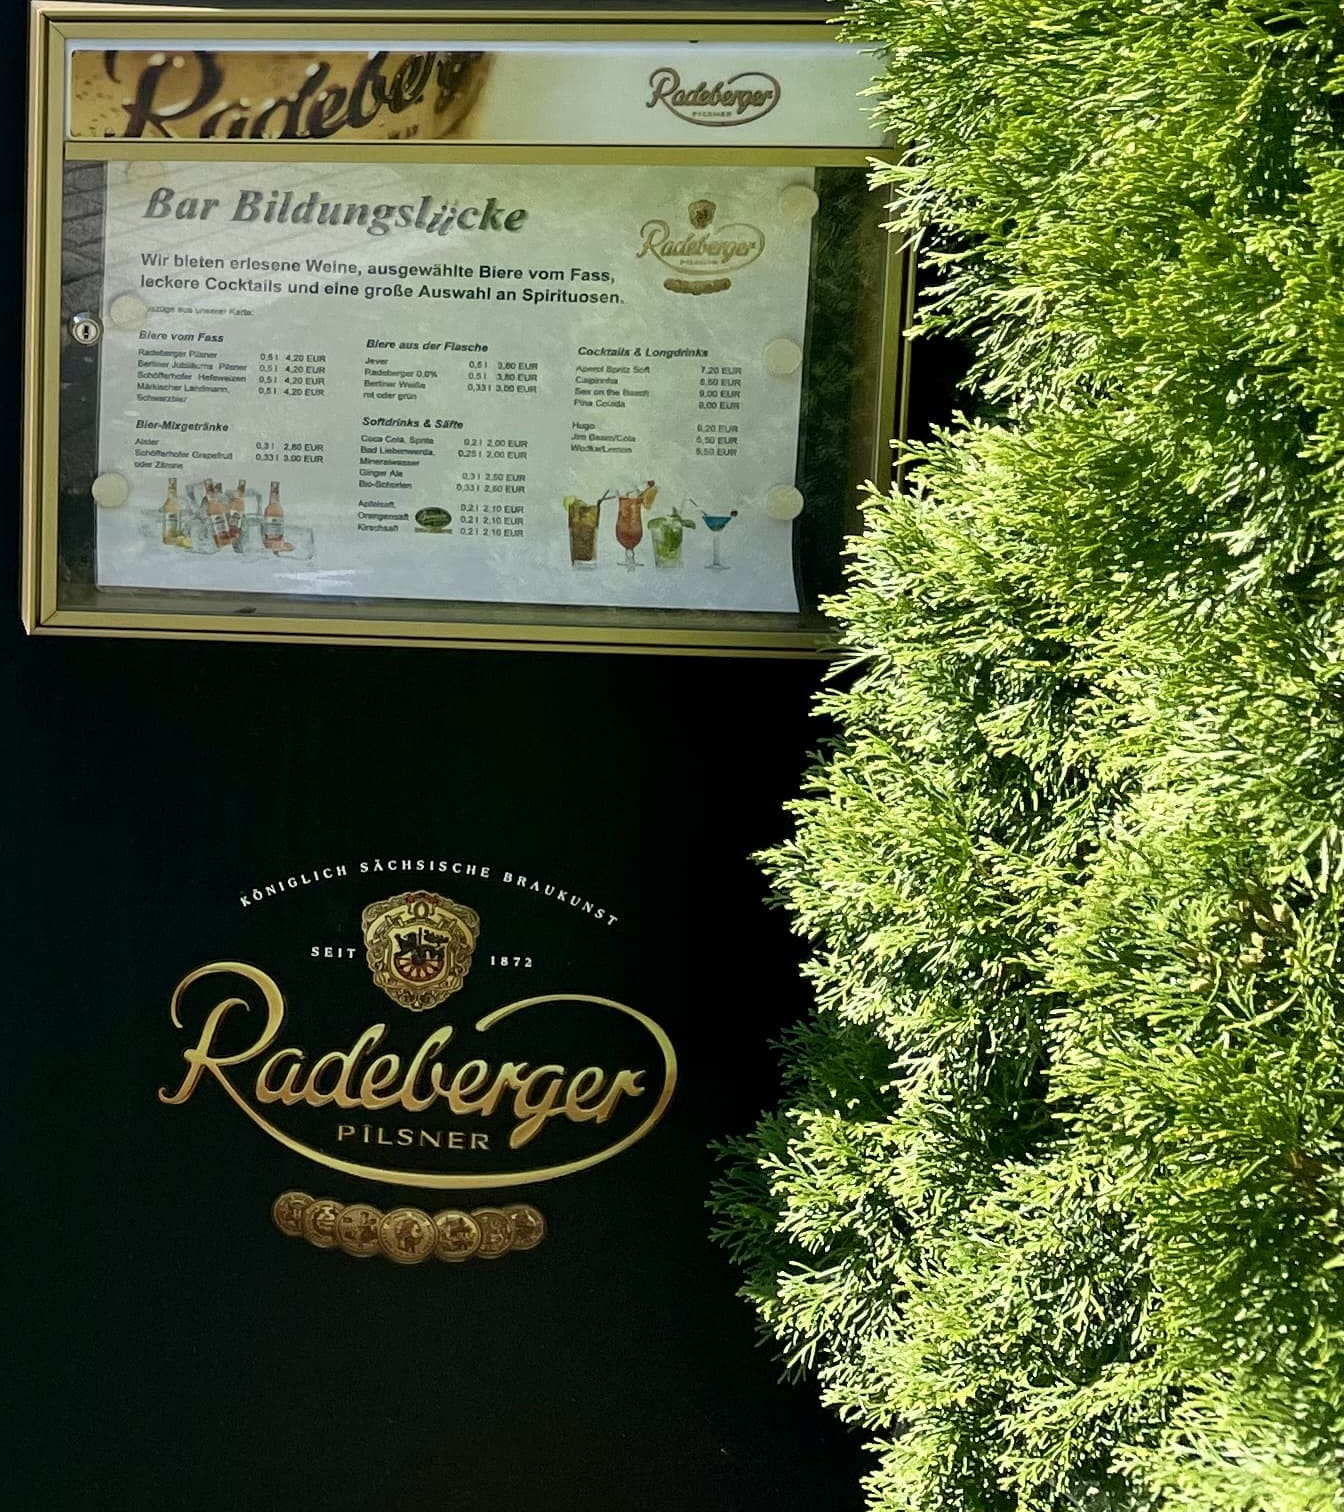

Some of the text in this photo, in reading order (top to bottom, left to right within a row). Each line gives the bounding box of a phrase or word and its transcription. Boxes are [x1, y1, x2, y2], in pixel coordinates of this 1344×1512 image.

[646, 67, 781, 127] Radeberger
[141, 187, 529, 236] Bar Bildungslücke
[636, 219, 765, 275] Radeberger
[141, 253, 615, 284] Wir bieten erlesene Weine, ausgewählte Biere vom Fass,
[141, 275, 625, 305] leckere Cocktails und eine große Auswahl an Spirituosen.
[139, 330, 224, 342] Biere vom Fass
[367, 339, 396, 349] Biere
[422, 341, 442, 350] der
[444, 342, 488, 352] Flasche
[138, 349, 186, 358] Radeberger
[189, 350, 217, 358] Pilsner
[306, 354, 326, 362] EUR
[578, 346, 709, 359] Cocktails & Longdrinks
[138, 359, 169, 368] Berliner
[219, 363, 247, 371] Pilsner
[306, 366, 325, 374] EUR
[518, 362, 538, 370] EUR
[721, 367, 742, 375] EUR
[198, 373, 246, 382] Hefeweizen
[305, 377, 325, 385] EUR
[364, 368, 414, 378] Radeberger
[364, 379, 396, 387] Berliner
[517, 385, 537, 393] EUR
[721, 379, 741, 387] EUR
[304, 388, 325, 396] EUR
[606, 388, 620, 396] the
[623, 389, 649, 397] Beach
[720, 390, 741, 398] EUR
[719, 401, 740, 410] EUR
[135, 419, 229, 432] Bier-Mixgetränke
[362, 417, 463, 429] Softdrinks & Säfte
[572, 421, 738, 433] Hugo EUR
[508, 440, 528, 448] EUR
[571, 433, 587, 441] Jim
[718, 437, 737, 445] EUR
[304, 443, 324, 452] EUR
[360, 446, 377, 454] Bad
[507, 451, 527, 460] EUR
[717, 448, 737, 456] EUR
[304, 455, 324, 463] EUR
[359, 469, 386, 478] Ginger
[389, 469, 403, 477] Ale
[506, 474, 526, 482] EUR
[505, 485, 525, 493] EUR
[504, 505, 524, 513] EUR
[504, 517, 524, 525] EUR
[504, 529, 524, 537] EUR
[240, 858, 619, 926] KÖNIGLICH SÄCHSISCHE BRAUKUNST
[310, 945, 534, 969] SEIT 1872
[159, 961, 678, 1189] Radeberger
[337, 1123, 491, 1151] PILSNER
